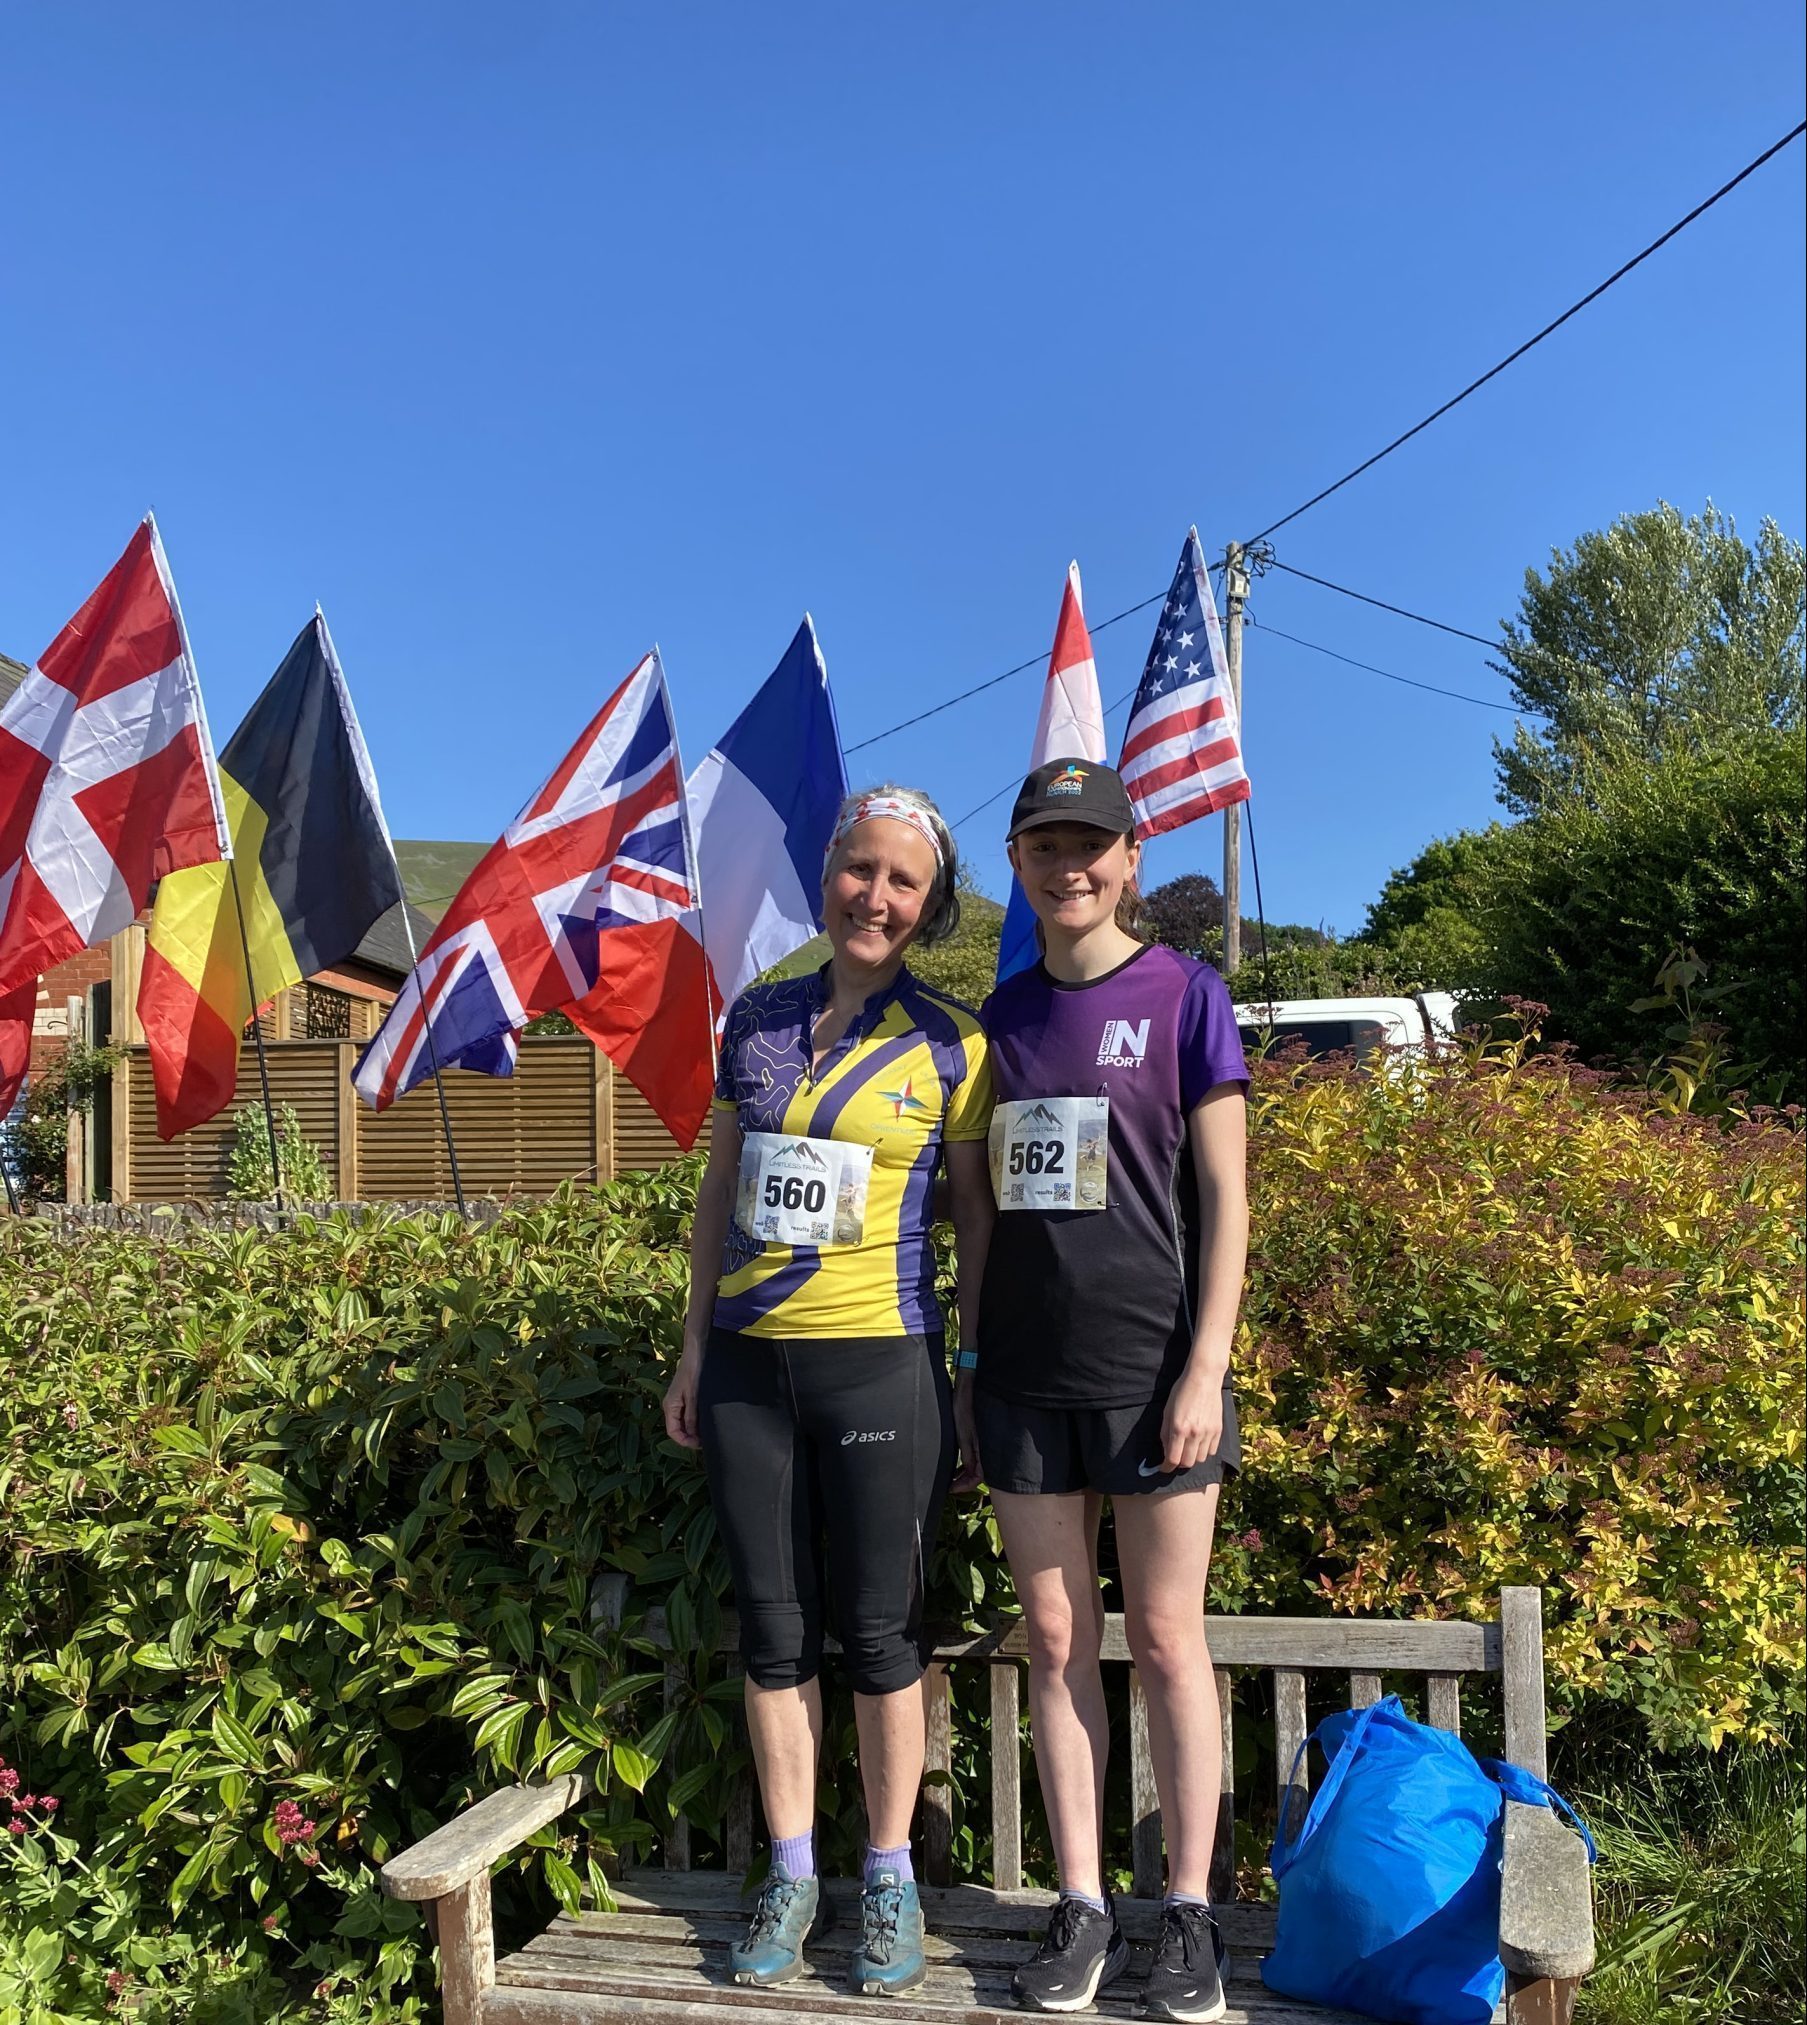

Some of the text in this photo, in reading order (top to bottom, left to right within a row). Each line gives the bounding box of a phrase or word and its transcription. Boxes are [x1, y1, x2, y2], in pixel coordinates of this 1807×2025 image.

[1101, 1022, 1115, 1053] WOMEN
[1095, 1055, 1145, 1068] SPORT
[1009, 1140, 1065, 1175] 562
[802, 1164, 827, 1173] TRAILS
[764, 1175, 826, 1213] 560
[790, 1224, 810, 1233] results
[858, 1430, 896, 1443] asics
